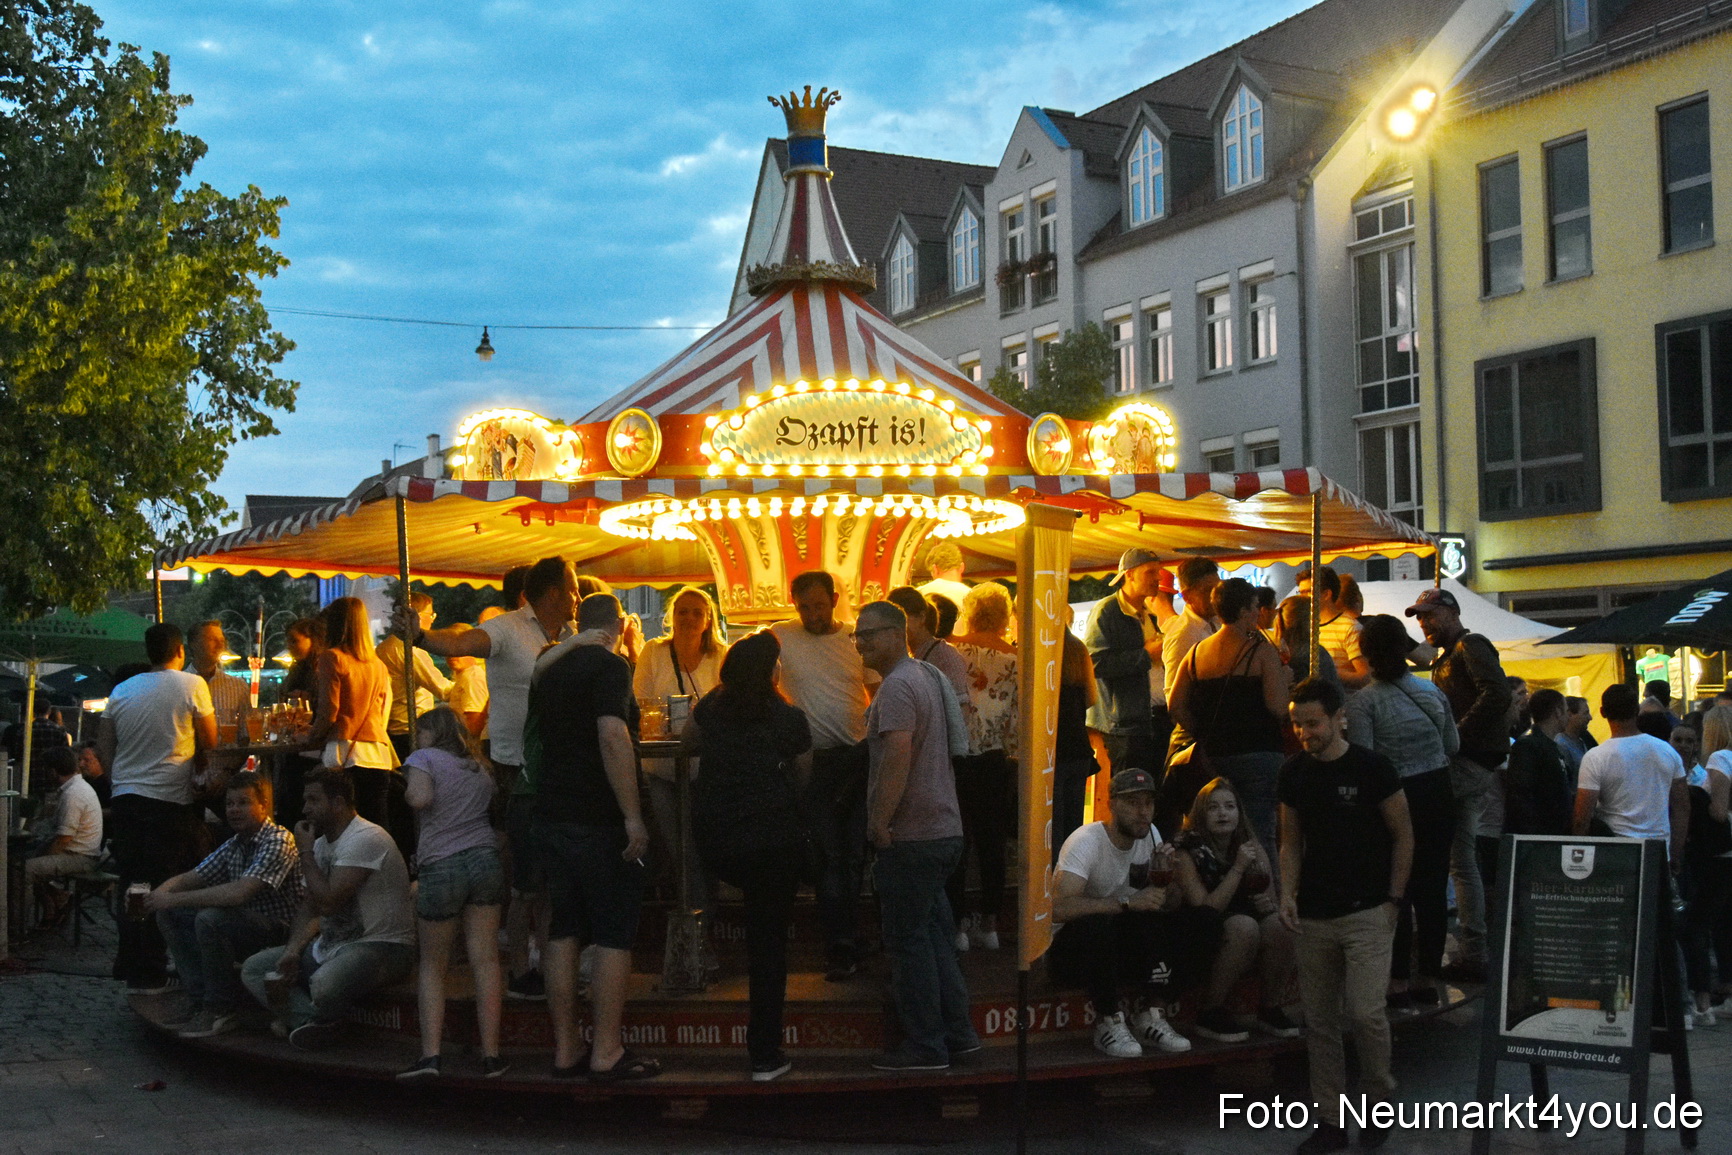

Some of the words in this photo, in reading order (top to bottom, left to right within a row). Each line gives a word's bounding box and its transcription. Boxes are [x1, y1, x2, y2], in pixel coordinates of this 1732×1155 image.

[775, 414, 879, 452] Ozapft
[890, 414, 926, 447] is!
[677, 1023, 721, 1044] man
[1506, 1043, 1622, 1065] www.lammsbraeu.de
